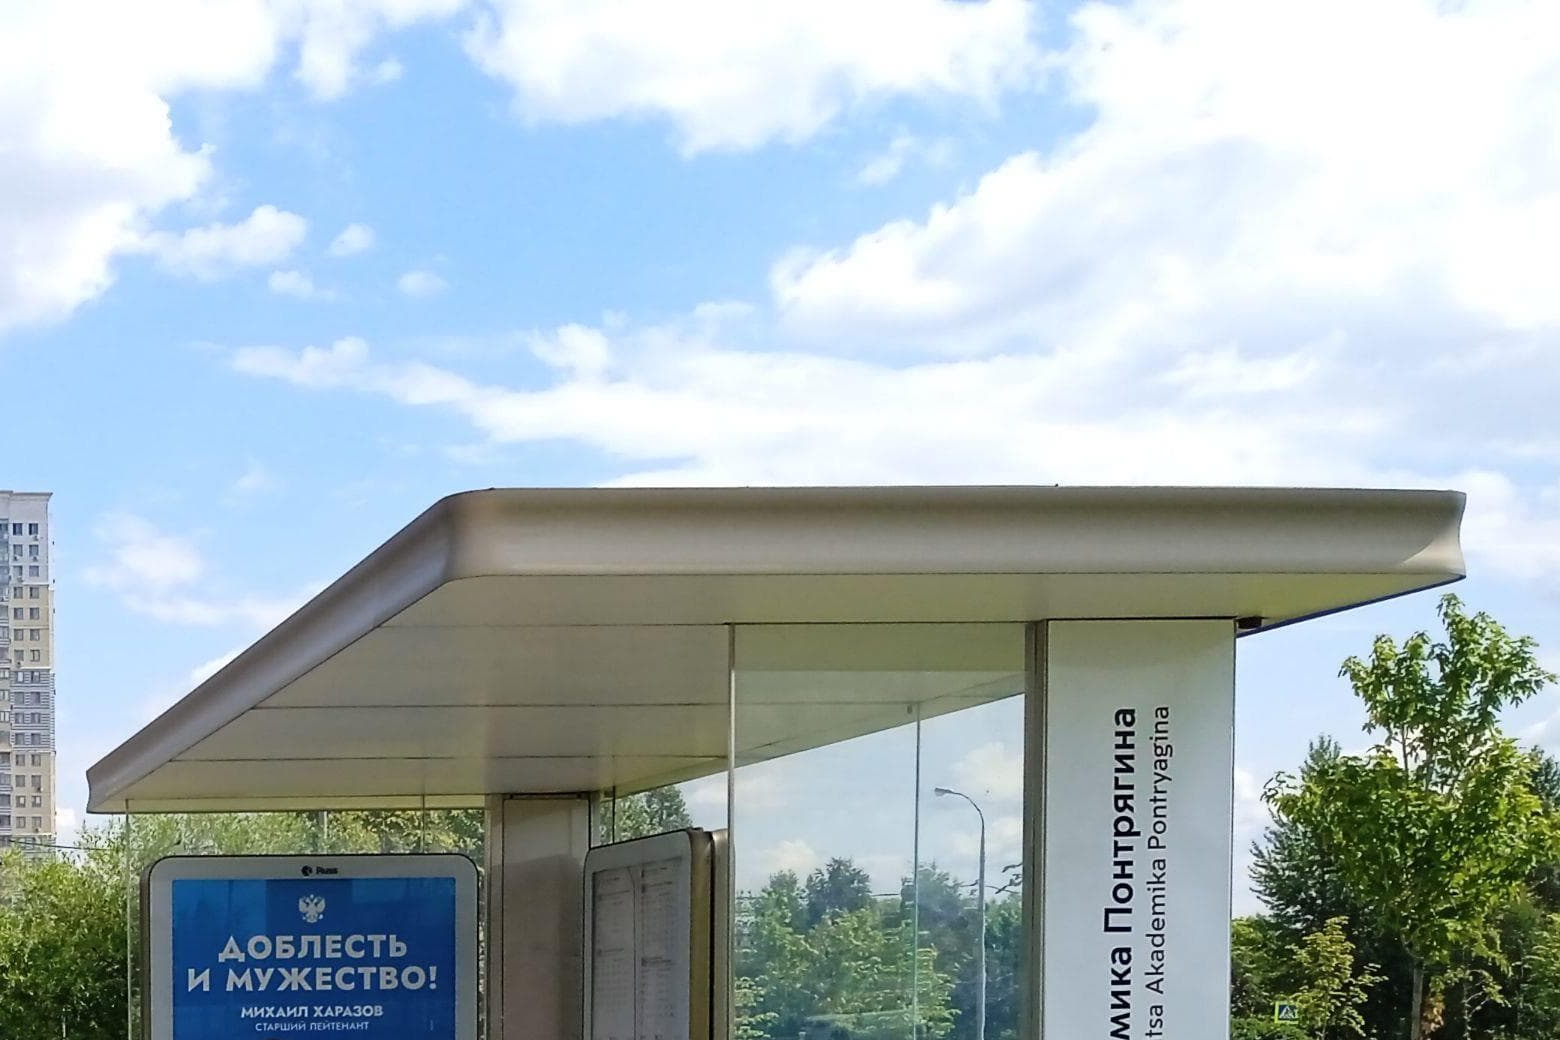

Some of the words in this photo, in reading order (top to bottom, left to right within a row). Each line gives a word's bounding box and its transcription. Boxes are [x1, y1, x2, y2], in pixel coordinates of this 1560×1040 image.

[1147, 706, 1174, 851] Pontryagina
[1103, 706, 1142, 933] Понтрягина
[1144, 858, 1167, 995] Akademika
[218, 934, 408, 963] ДОБЛЕСТЬ
[187, 969, 211, 992] И
[225, 965, 438, 992] МУЖЕСТВО!
[240, 1006, 309, 1018] МИХАИЛ
[313, 1005, 384, 1017] ХАРАЗОВ
[255, 1021, 306, 1031] СТАРШИЙ
[310, 1020, 370, 1031] ЛЕЙТЕНАНТ
